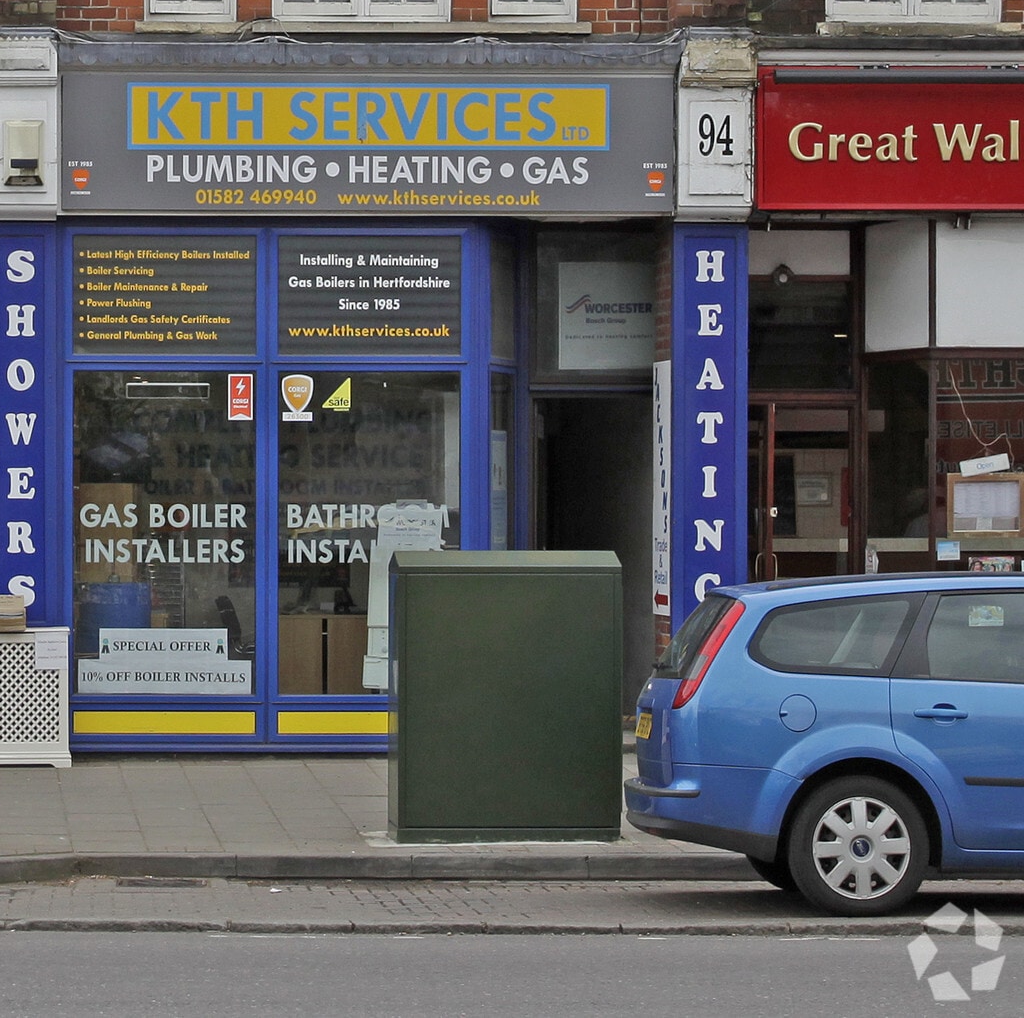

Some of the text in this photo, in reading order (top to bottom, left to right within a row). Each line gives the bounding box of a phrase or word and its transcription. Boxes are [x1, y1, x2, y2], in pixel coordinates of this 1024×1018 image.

[147, 90, 590, 141] KTH SERVICES LTD
[698, 113, 734, 157] 94
[787, 121, 918, 162] Great
[147, 154, 589, 185] PLUMBING HEATING GAS
[195, 189, 541, 206] 01582 469940 www.kthservices.co.uk
[86, 250, 250, 261] Latest High Efficiency Boilers Installed
[299, 254, 439, 269] Installing & Maintaining
[86, 266, 155, 277] Boiler Servicing
[86, 282, 209, 293] Boiler Maintenance & Repair
[288, 276, 451, 289] Gas Boilers in Hertfordshire
[86, 299, 152, 309] Power Flushing
[338, 298, 401, 311] Since 1985
[584, 303, 653, 314] WORCESTER
[86, 315, 231, 326] Landlords Gas Safety Certificates
[86, 331, 218, 342] General Plumbing & Gas Work
[288, 324, 451, 338] www.kthservices.co.uk
[328, 397, 350, 407] safe
[5, 249, 37, 608] SHOWERS
[654, 366, 669, 534] JACKSONS
[79, 502, 248, 529] GAS BOILER
[85, 537, 246, 564] INSTALLERS
[287, 538, 370, 564] INSTA
[654, 537, 668, 552] Trade
[112, 640, 212, 652] SPECIAL OFFER
[81, 671, 247, 683] 10% OFF BOILER INSTALLS
